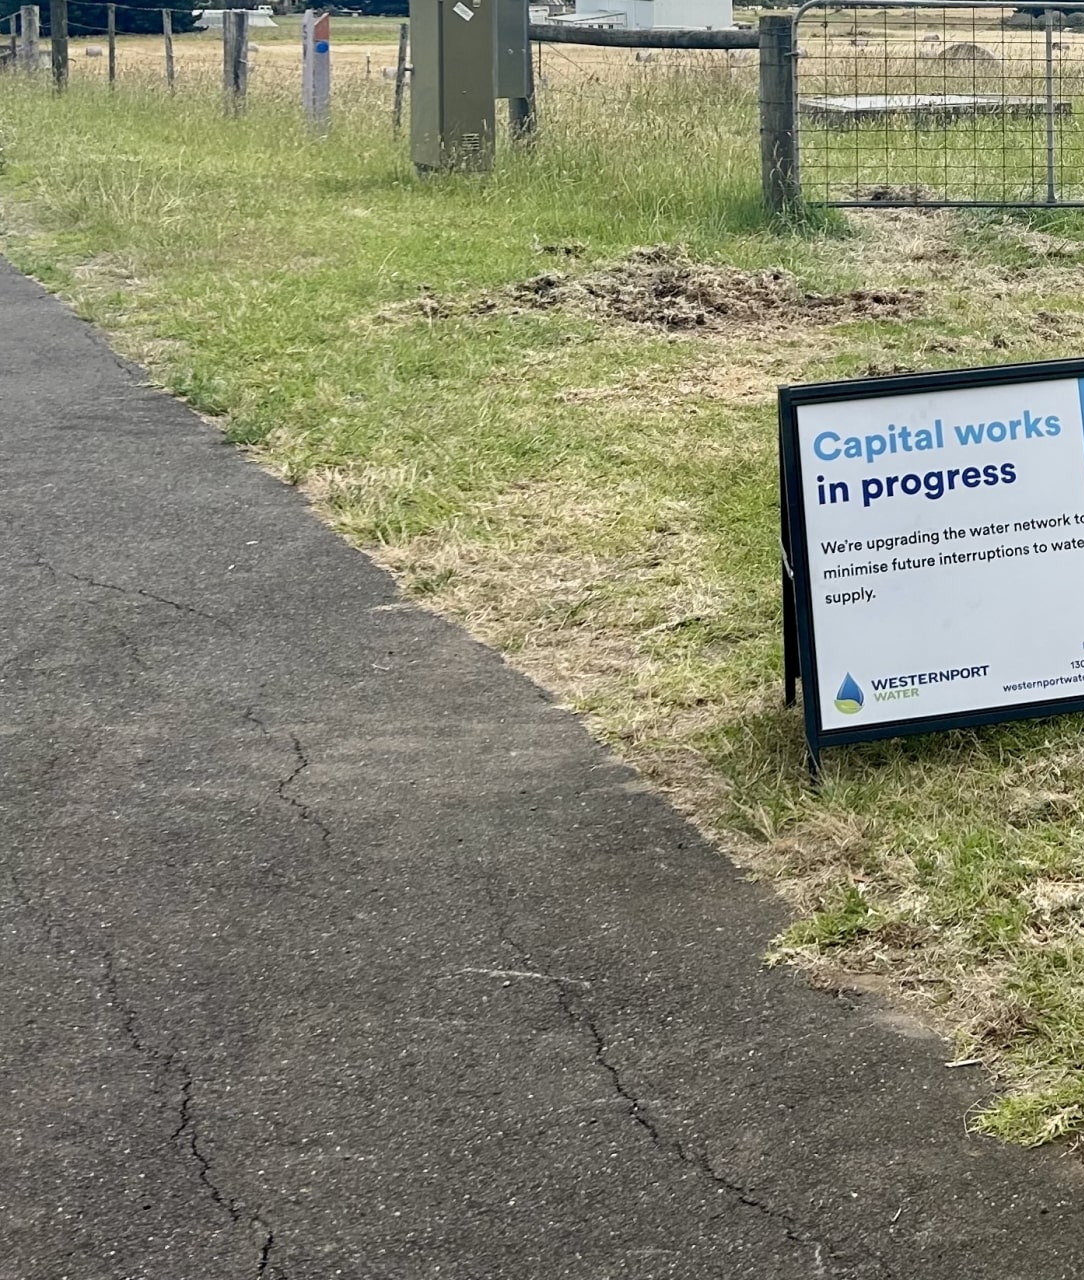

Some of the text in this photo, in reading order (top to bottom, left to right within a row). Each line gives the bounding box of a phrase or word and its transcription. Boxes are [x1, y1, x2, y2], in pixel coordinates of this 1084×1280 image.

[813, 410, 1062, 463] Capital works
[816, 462, 1017, 507] in progress
[821, 539, 863, 555] We're
[866, 531, 940, 551] upgrading
[943, 527, 966, 541] the
[969, 523, 1010, 537] water
[1013, 514, 1071, 533] network
[823, 562, 888, 580] minimise
[891, 556, 936, 571] future
[939, 545, 1030, 566] interruptions
[1033, 542, 1048, 554] to
[825, 587, 877, 605] supply.
[871, 665, 990, 691] WESTERNPORT
[873, 687, 920, 703] WATER
